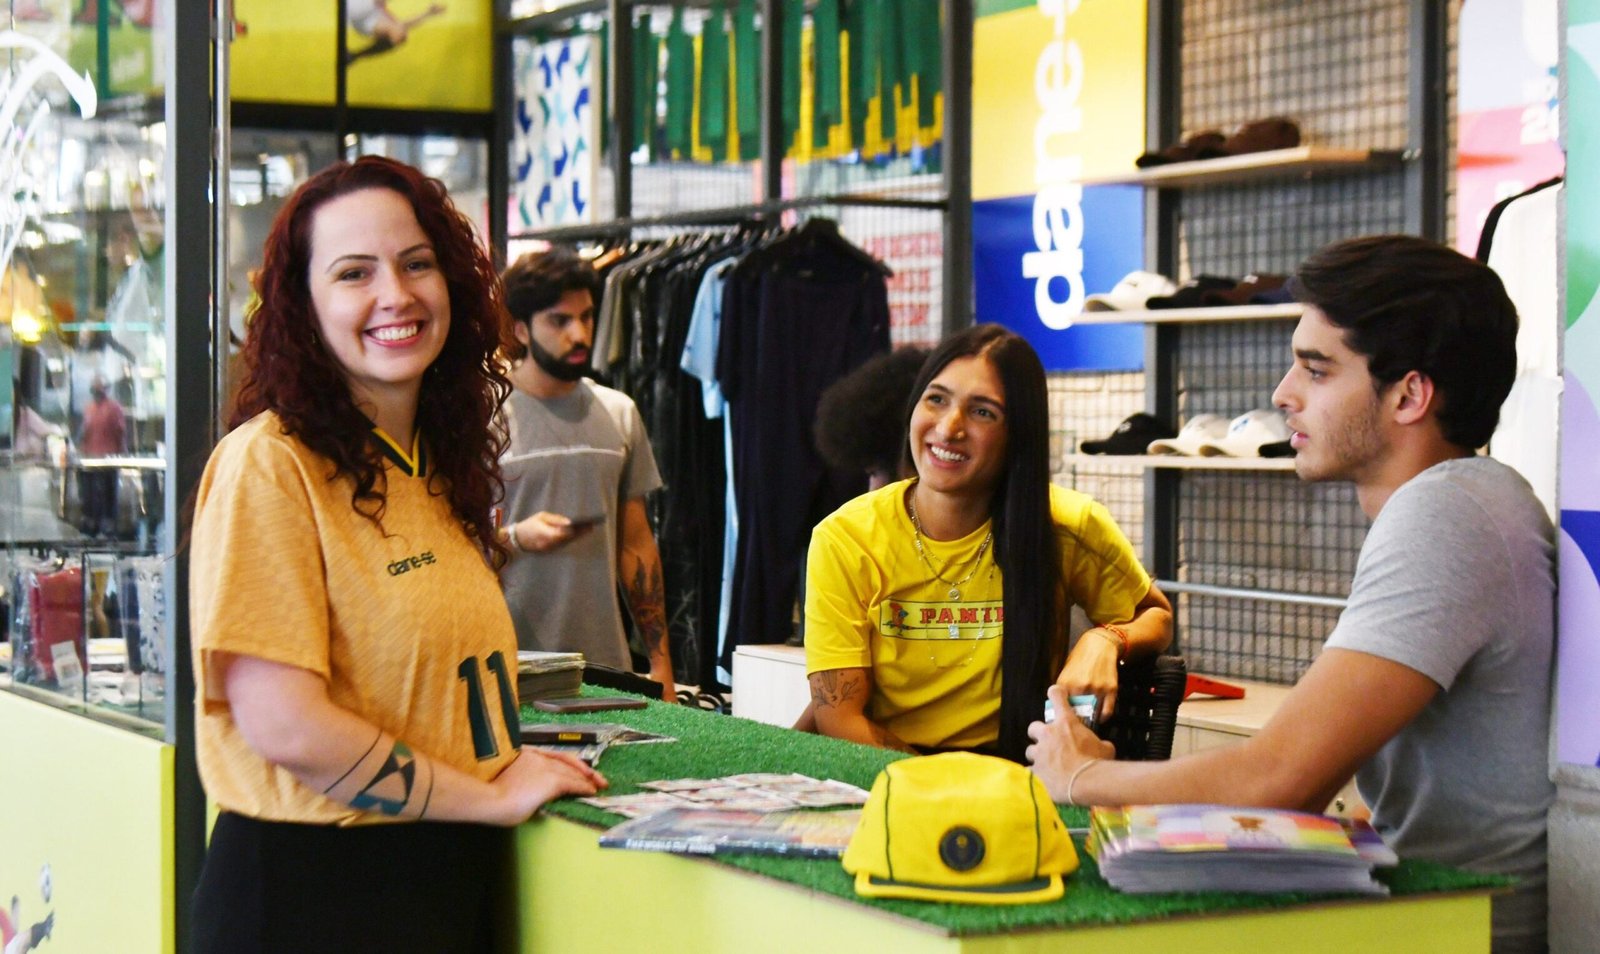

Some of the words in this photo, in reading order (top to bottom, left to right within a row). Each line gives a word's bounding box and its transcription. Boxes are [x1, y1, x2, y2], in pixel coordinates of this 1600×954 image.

[1022, 0, 1085, 330] dane-
[387, 550, 437, 576] dane-se
[919, 606, 1004, 624] PANI
[457, 650, 521, 760] 11
